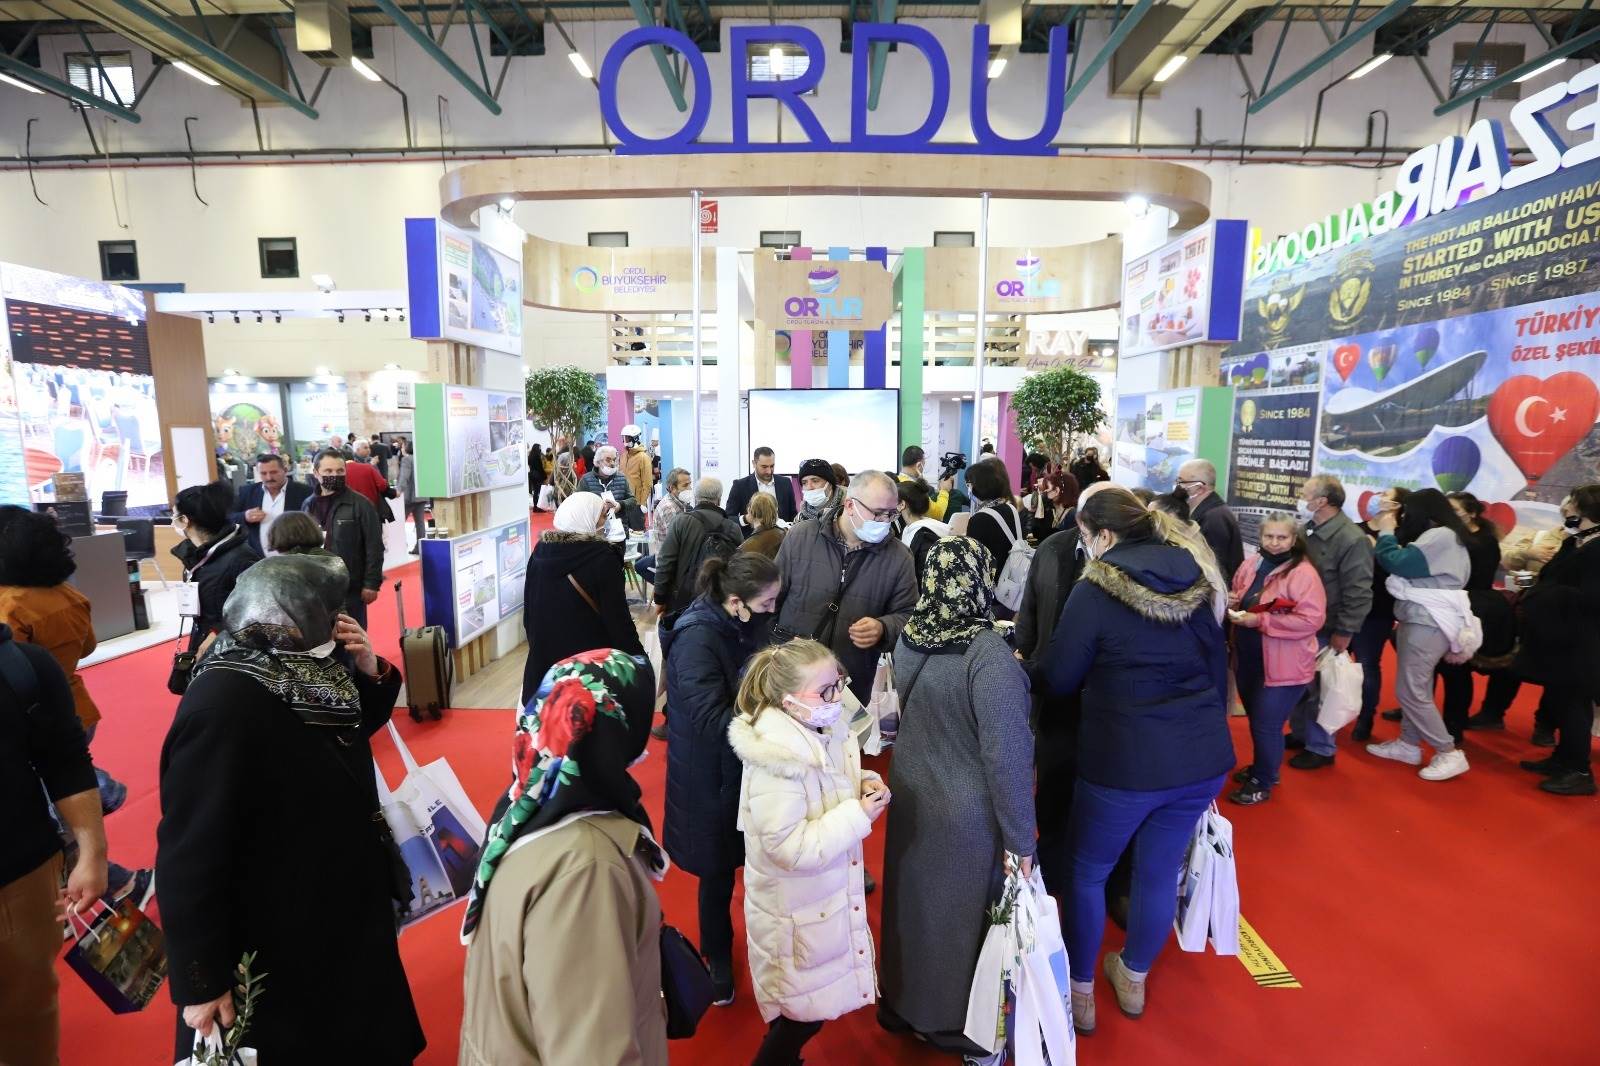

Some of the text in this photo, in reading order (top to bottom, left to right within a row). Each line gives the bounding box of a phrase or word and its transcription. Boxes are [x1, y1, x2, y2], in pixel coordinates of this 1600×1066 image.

[599, 21, 1069, 149] ORDU
[1405, 181, 1600, 254] THE HOT AIR BALLOON HAV
[1402, 237, 1484, 275] STARTED
[1493, 215, 1553, 250] WITH
[1397, 258, 1590, 311] SINCE 1984 SINCE 1987
[1413, 262, 1464, 287] TURKEY
[784, 296, 864, 320] ORTUR
[1515, 304, 1600, 337] TÜRKİY
[1511, 344, 1551, 362] ÖZEL
[1259, 407, 1311, 420] SINCE 1984
